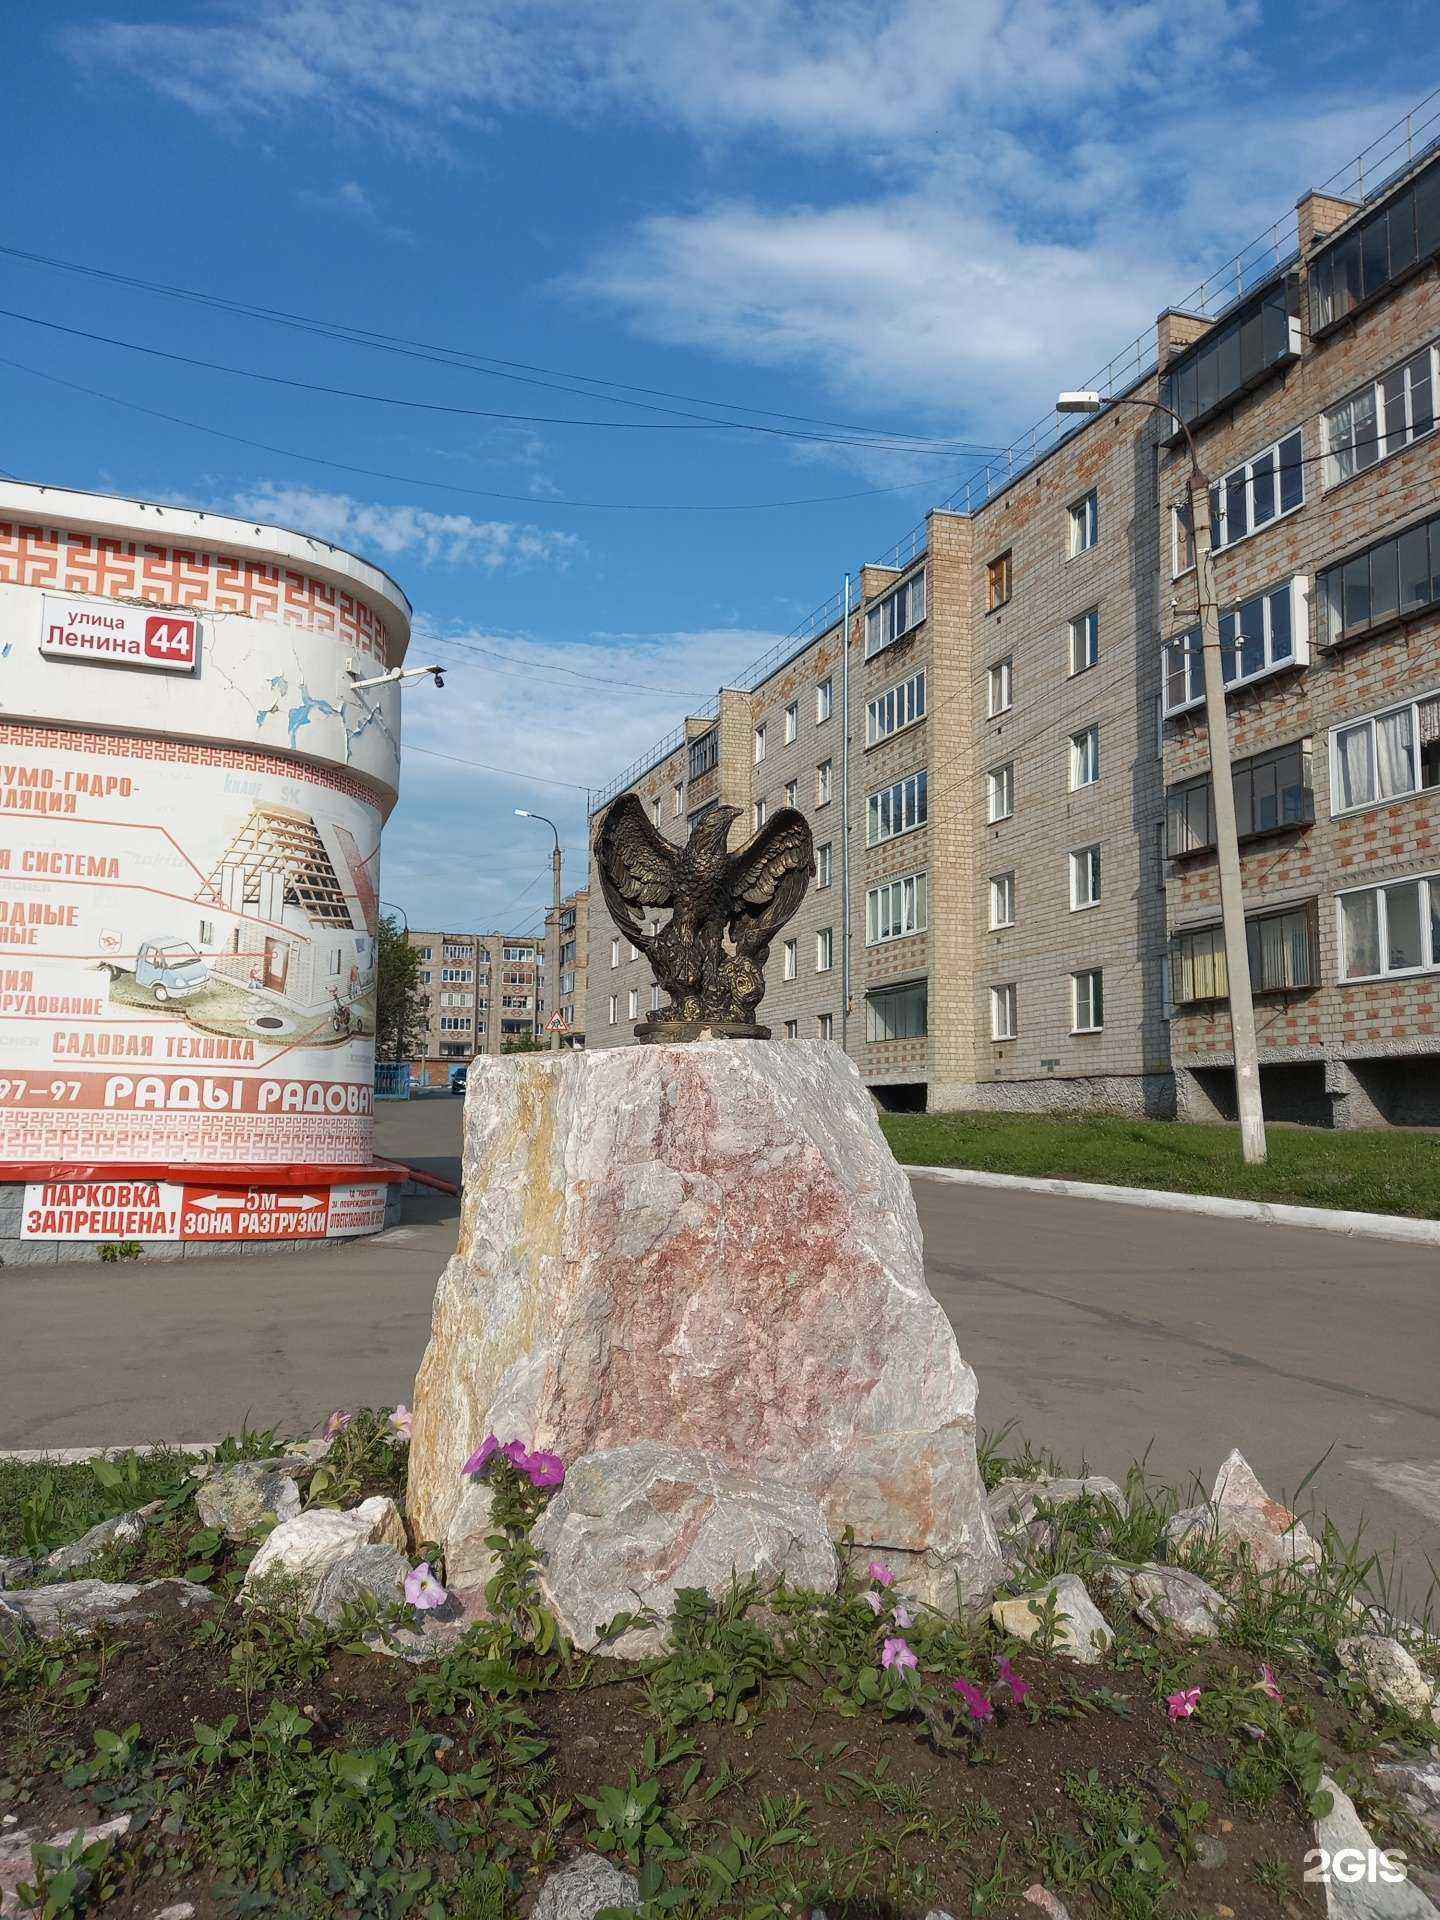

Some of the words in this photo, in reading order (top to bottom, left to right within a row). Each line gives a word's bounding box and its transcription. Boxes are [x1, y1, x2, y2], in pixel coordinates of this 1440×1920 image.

[68, 611, 125, 630] улица
[47, 625, 140, 654] Ленина
[150, 624, 190, 655] 44
[0, 765, 140, 798] УМО-ГИДРО-
[0, 788, 77, 814] ЛЯЦИЯ
[22, 850, 119, 878] СИСТЕМА
[0, 969, 33, 992] ИЯ
[0, 993, 103, 1016] РУДОВАНИЕ
[52, 1031, 154, 1058] САДОВАЯ
[165, 1036, 255, 1060] ТЕХНИКА
[104, 1075, 243, 1110] РАДЫ
[41, 1183, 160, 1208] ПАРКОВКА
[26, 1210, 176, 1238] ЗАПРЕЩЕНА!
[184, 1212, 233, 1234] ЗОНА
[238, 1211, 326, 1234] РАЗГРУЗКИ
